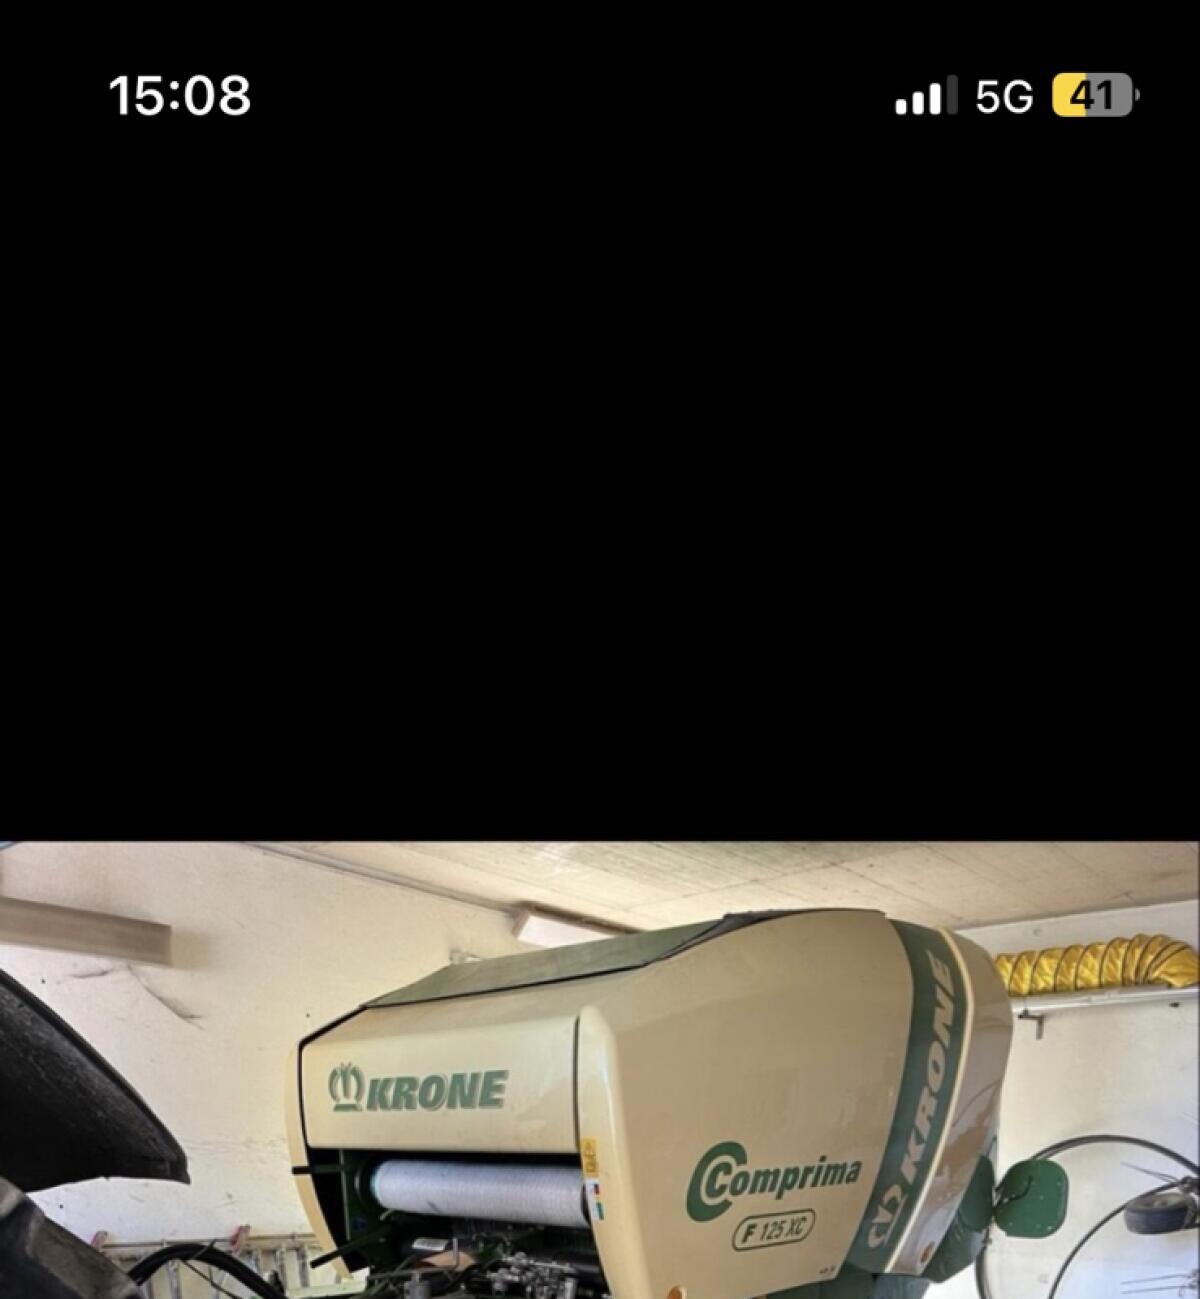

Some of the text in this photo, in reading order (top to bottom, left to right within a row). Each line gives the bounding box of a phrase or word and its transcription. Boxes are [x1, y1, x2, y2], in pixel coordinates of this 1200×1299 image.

[900, 949, 956, 1185] KRONE
[366, 1069, 508, 1112] KRONE
[741, 1215, 808, 1243] F 125 XC
